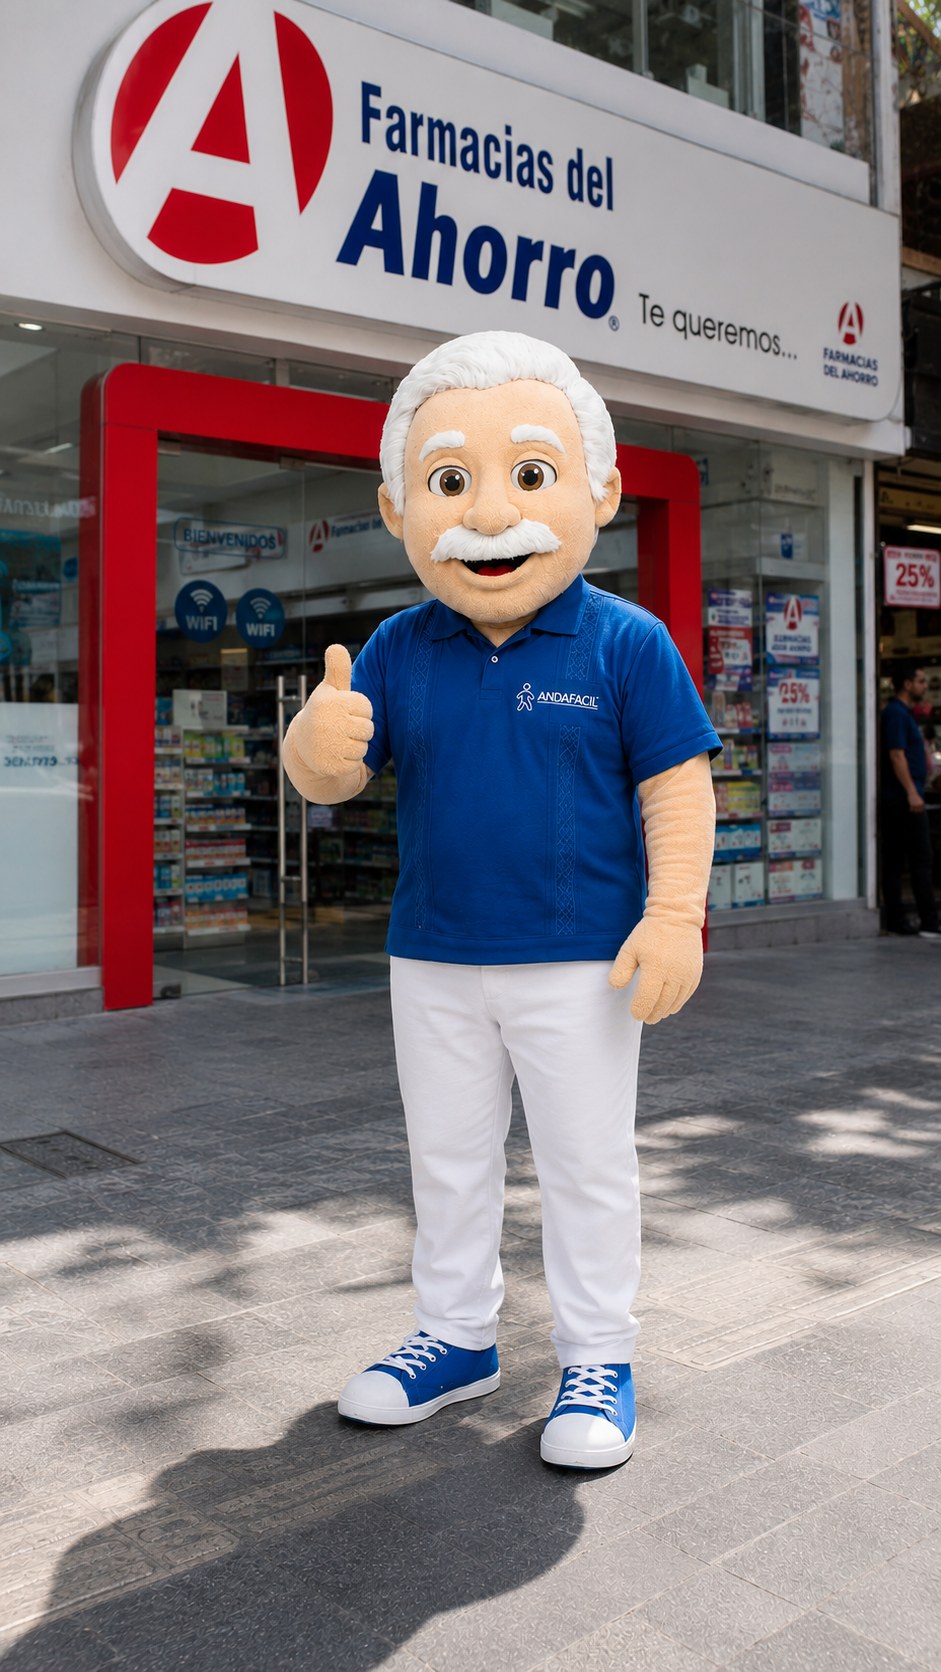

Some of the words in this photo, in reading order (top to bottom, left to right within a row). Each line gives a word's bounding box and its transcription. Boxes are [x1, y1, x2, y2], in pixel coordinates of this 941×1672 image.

[361, 81, 554, 194] Farmacias
[567, 147, 614, 211] del
[639, 293, 664, 327] Te
[672, 309, 798, 360] queremos...
[823, 347, 879, 372] FARMACIAS
[823, 364, 840, 379] DEL
[841, 368, 879, 387] AHORRO
[183, 528, 277, 550] BIENVENIDOS
[895, 562, 935, 589] 25%
[185, 615, 218, 632] WIFI
[245, 622, 276, 637] WIFI
[537, 691, 599, 708] ANDAFACIL
